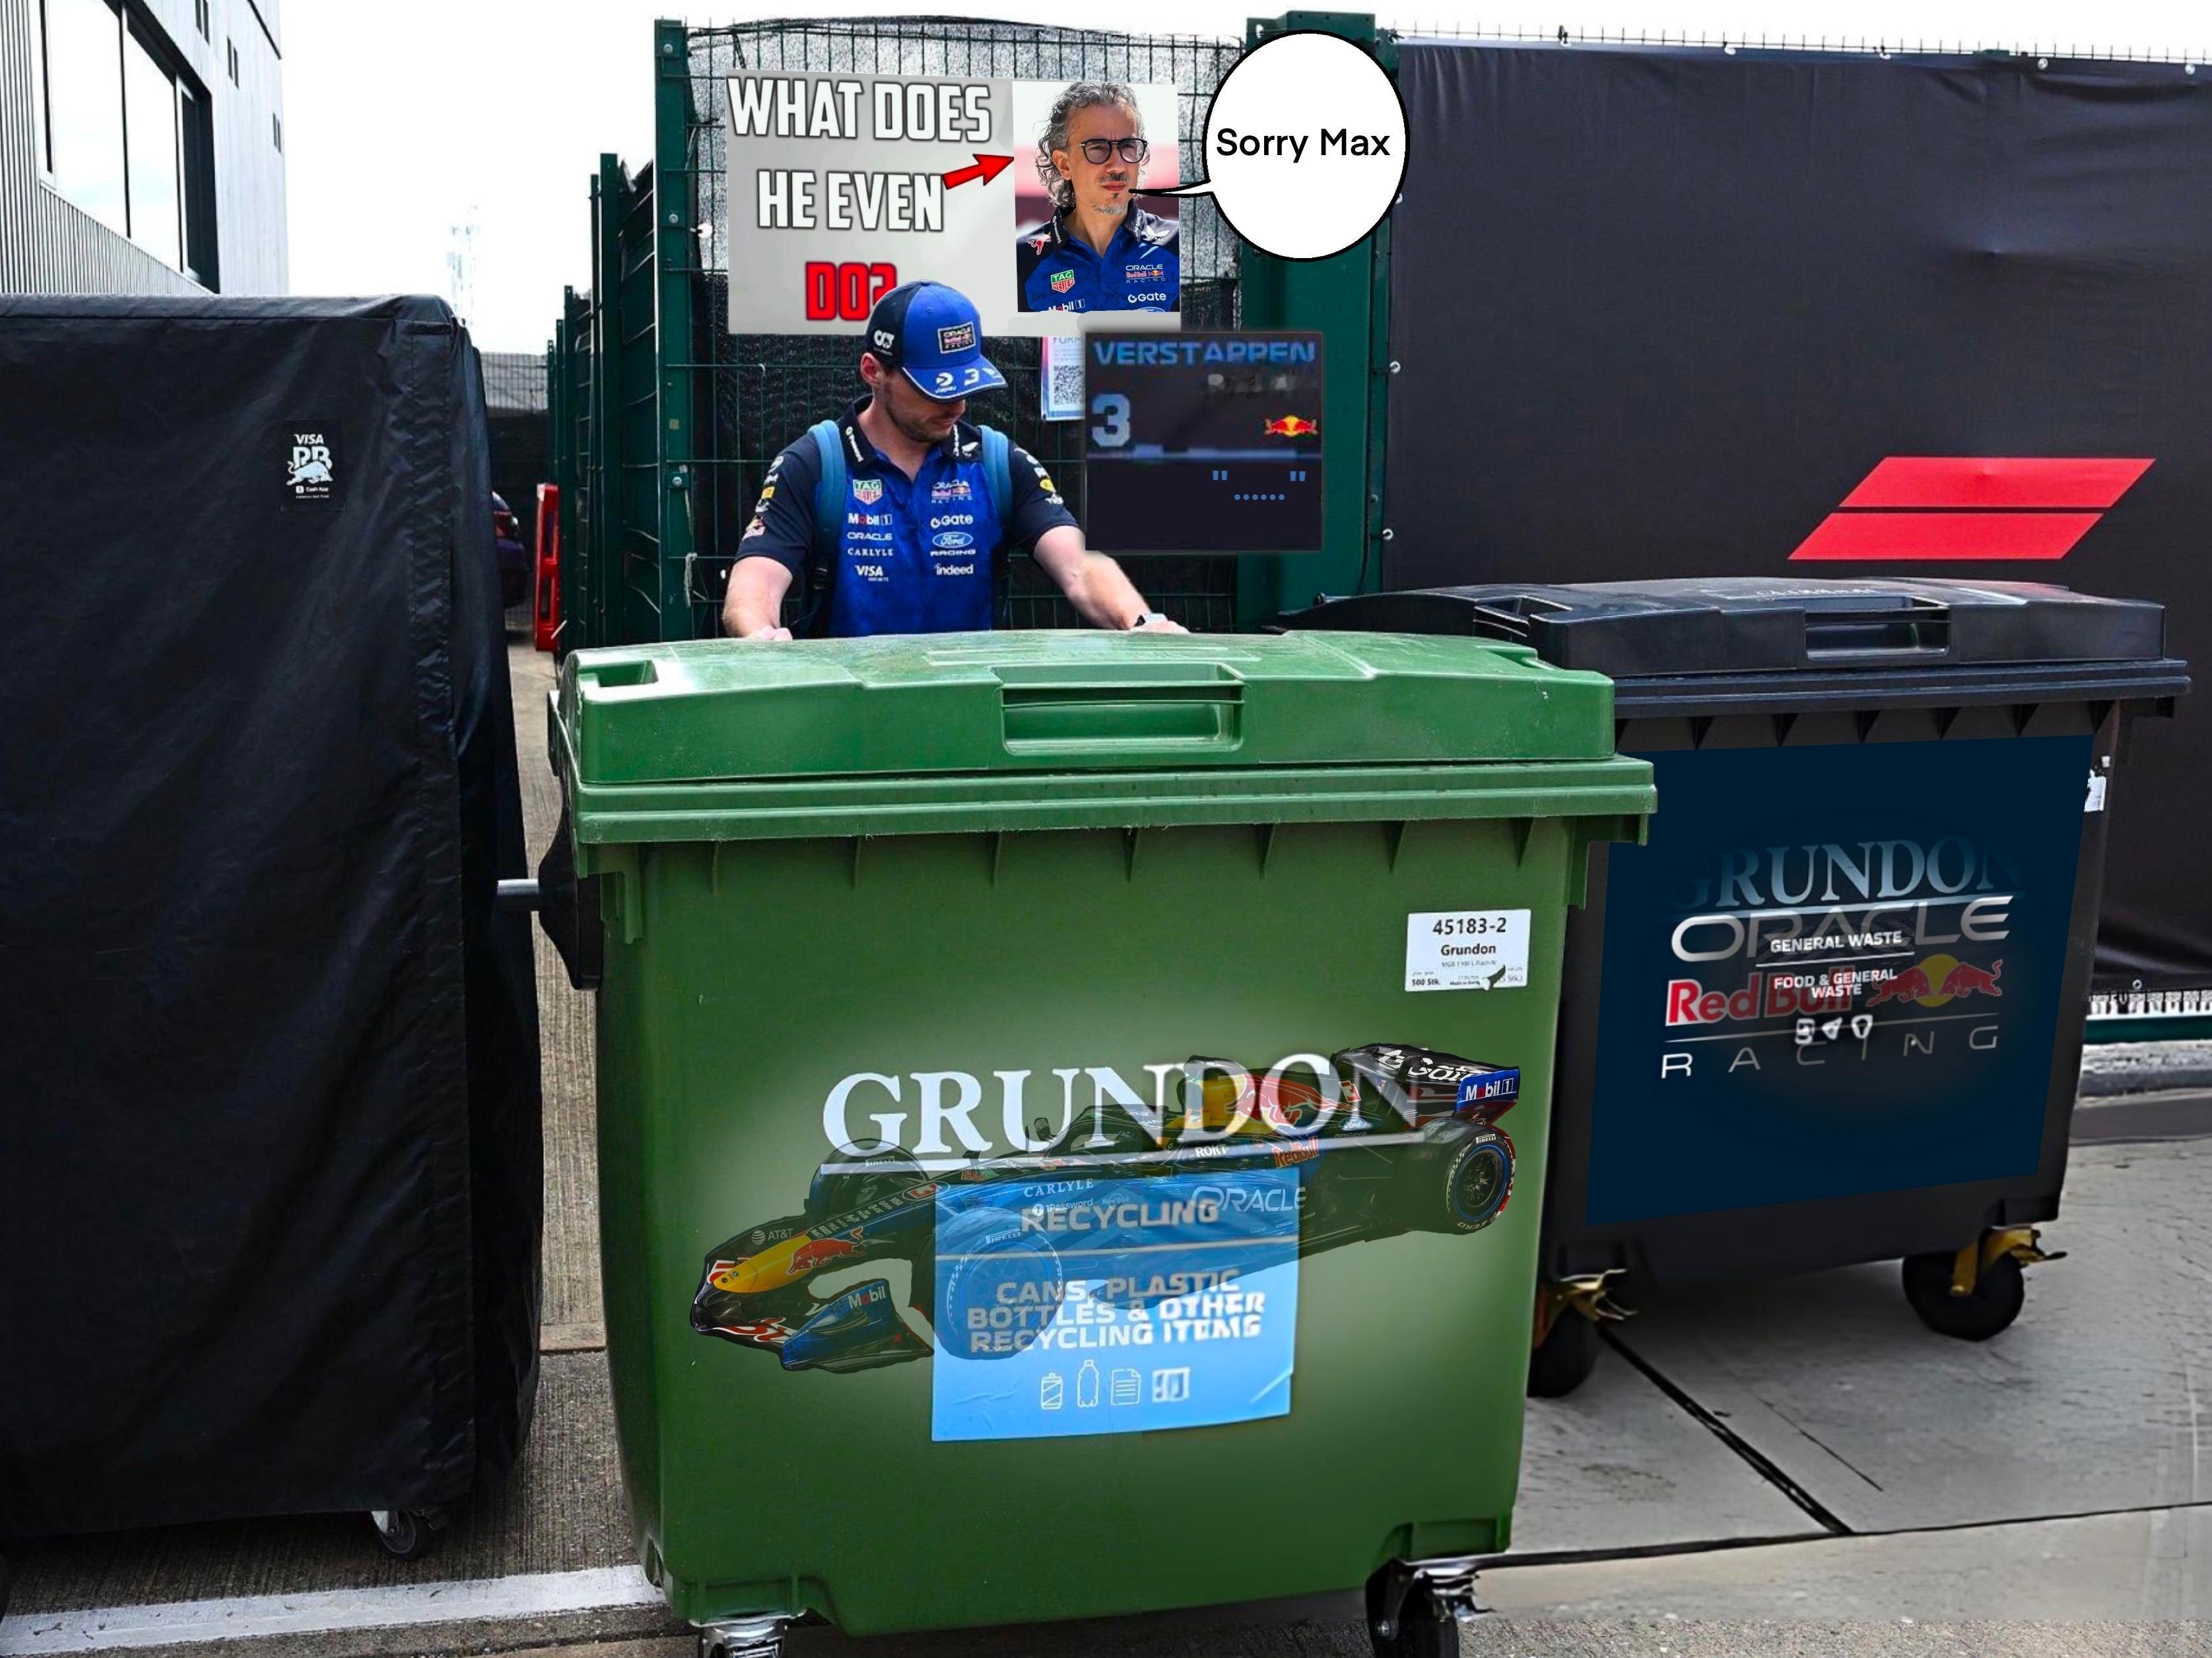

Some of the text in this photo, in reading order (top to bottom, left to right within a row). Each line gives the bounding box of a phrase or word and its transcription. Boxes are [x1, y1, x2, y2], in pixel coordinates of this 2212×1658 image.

[1053, 271, 1072, 282] TAG
[1052, 279, 1074, 291] HEUER
[1137, 292, 1166, 301] Gate
[1093, 341, 1315, 366] VERSTAPPEN
[1091, 393, 1131, 448] 3
[294, 434, 324, 445] VISA
[855, 481, 879, 490] TAG
[848, 514, 879, 525] Mobil
[940, 514, 974, 526] Gate
[847, 532, 892, 541] ORACLE
[941, 534, 965, 546] Ford
[848, 548, 894, 556] CARLYLE
[855, 566, 883, 577] VISA
[935, 564, 974, 576] indeed
[1667, 834, 2024, 910] GRUNDON
[1432, 917, 1506, 935] 45183-2
[1671, 896, 2013, 962] ORACLE
[1440, 943, 1496, 956] Grundon
[1770, 931, 1902, 953] GENERAL WASTE
[1774, 968, 1898, 989] FOOD & GENERAL
[1666, 965, 1856, 1027] Red Bull
[1811, 983, 1862, 998] WASTE
[1661, 1025, 1999, 1078] RACING
[1465, 1080, 1500, 1100] Mobil
[822, 1047, 1429, 1158] GRUNDON
[1344, 1119, 1362, 1128] Ford
[1475, 1133, 1496, 1144] PIRELLI
[1195, 1144, 1226, 1157] ROKT
[865, 1156, 896, 1167] PIRELLI
[1024, 1178, 1094, 1197] CARLYLE
[1046, 1199, 1093, 1212] 1Password
[1191, 1186, 1306, 1212] ORACLE
[1021, 1199, 1219, 1234] RECYCLING
[768, 1228, 793, 1241] AT&T
[985, 1228, 1021, 1244] PIRELLI
[997, 1270, 1240, 1305] CANS, PLASTIC
[848, 1286, 886, 1309] Mobil
[967, 1292, 1265, 1330] BOTTLES & OTHER
[970, 1314, 1261, 1353] RECYCLING ITEMS
